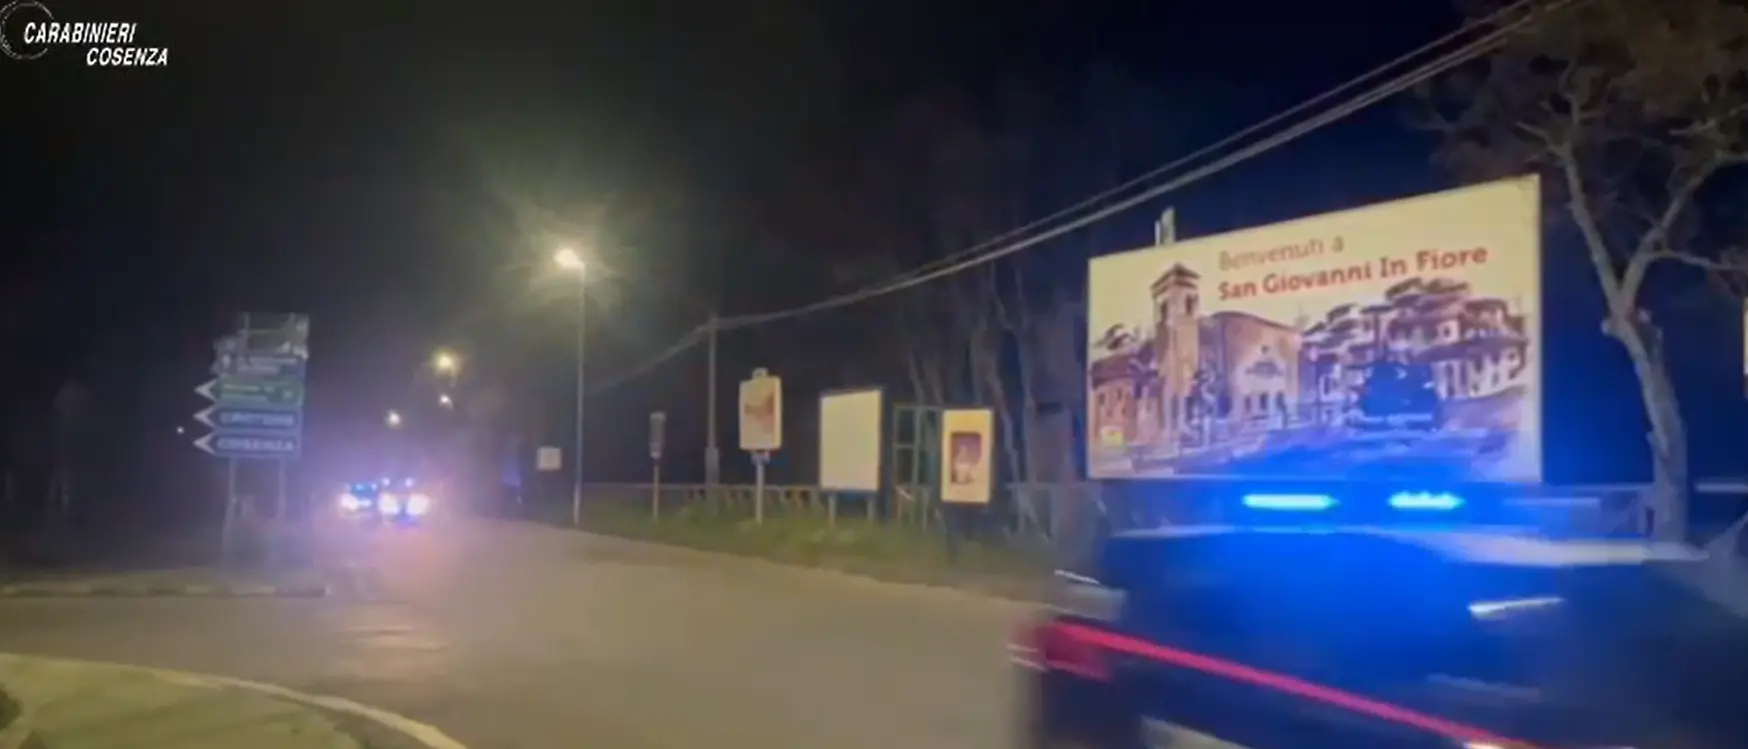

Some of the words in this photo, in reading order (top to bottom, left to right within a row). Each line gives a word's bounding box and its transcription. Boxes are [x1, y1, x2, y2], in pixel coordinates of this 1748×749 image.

[1218, 280, 1257, 301] San
[1262, 261, 1373, 295] Giovanni
[1379, 256, 1407, 278] In
[1416, 246, 1488, 273] Fiore
[1219, 237, 1325, 271] Benvenuti
[1331, 236, 1345, 254] a
